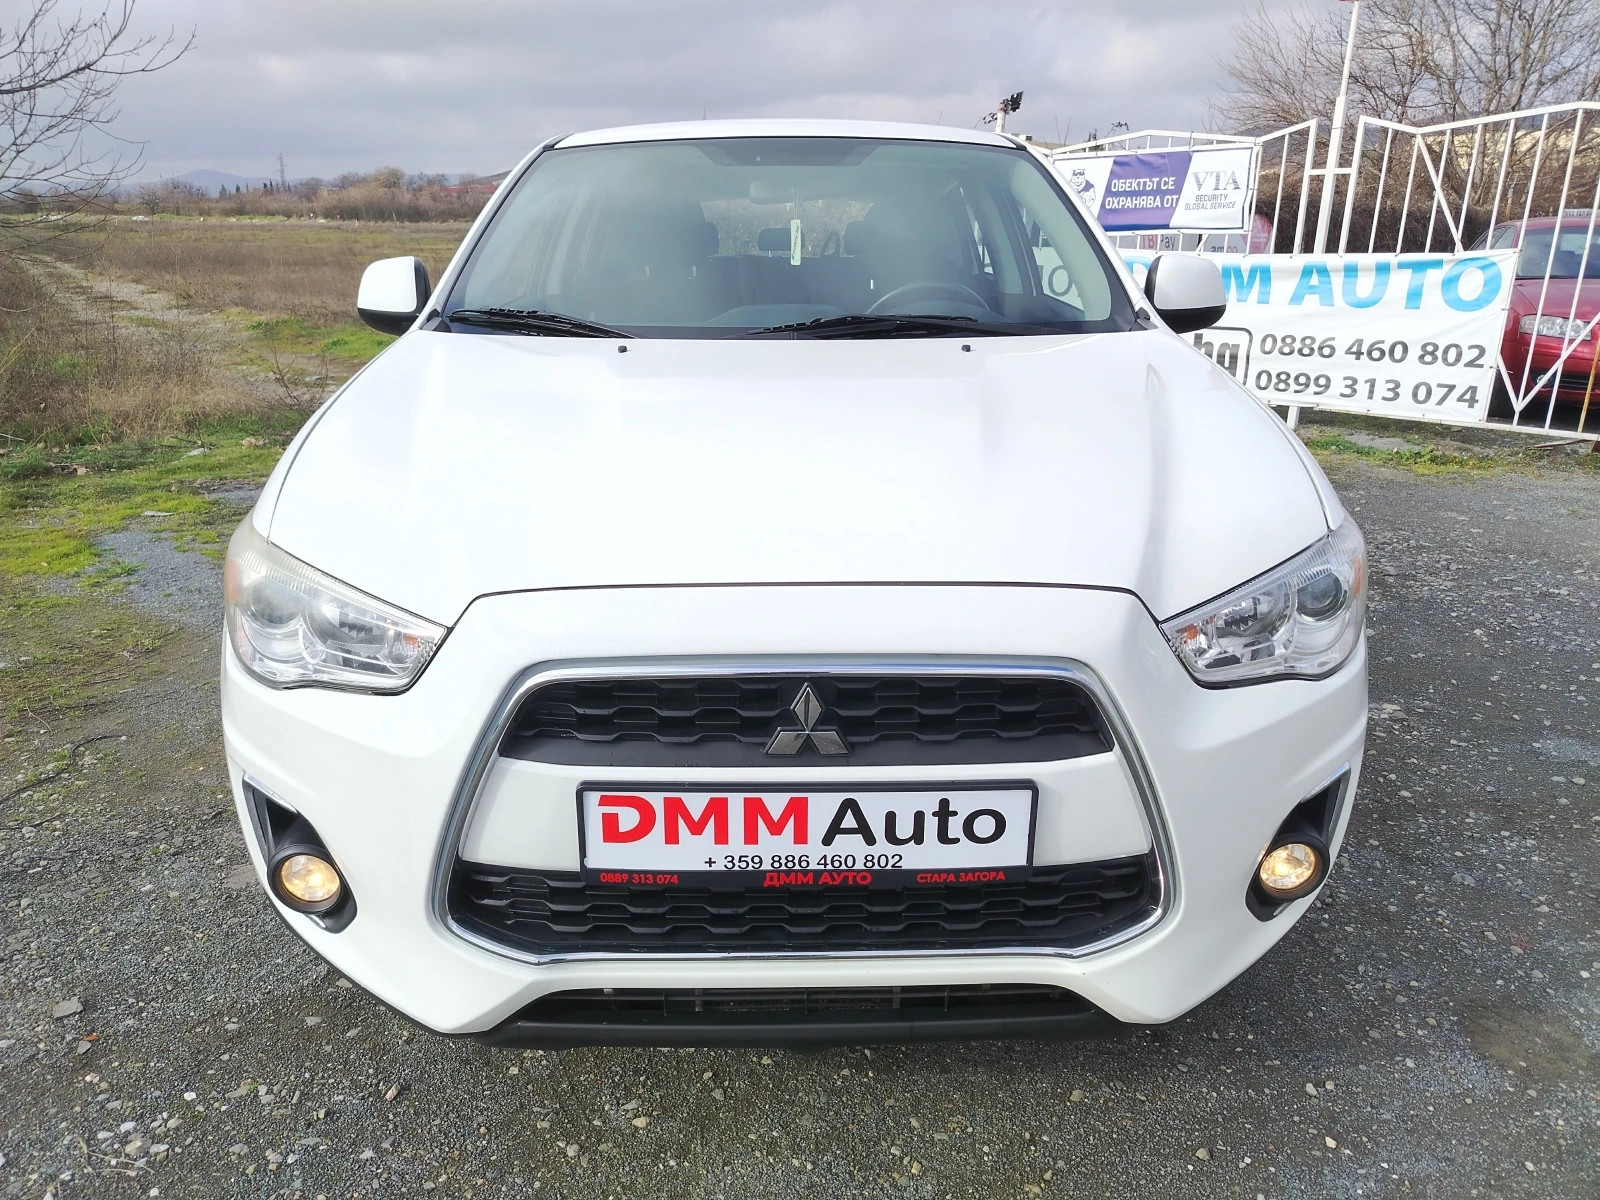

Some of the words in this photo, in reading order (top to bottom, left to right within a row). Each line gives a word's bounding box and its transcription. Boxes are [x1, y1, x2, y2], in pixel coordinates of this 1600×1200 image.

[1111, 178, 1159, 192] ОБЕКТЪТ
[1161, 177, 1176, 190] СЕ
[1192, 170, 1241, 191] VTA
[1105, 196, 1161, 209] ОХРАНЯВА
[1164, 195, 1179, 208] ОТ
[1195, 194, 1228, 203] SECURITY
[1184, 203, 1208, 211] GLOBAL
[1209, 202, 1236, 210] SERVICE
[1288, 257, 1502, 312] AUTO
[1259, 333, 1336, 359] 0886
[1344, 338, 1409, 363] 460
[1418, 342, 1486, 368] 802
[1255, 370, 1331, 395] 0899
[1339, 376, 1401, 402] 313
[1411, 382, 1479, 409] 074
[597, 795, 809, 845] DMM
[820, 797, 1007, 847] Auto
[724, 854, 763, 870] 359
[770, 854, 810, 869] 886
[816, 854, 856, 869] 460
[863, 853, 903, 869] 802
[632, 873, 654, 884] 313
[656, 874, 678, 884] 074
[763, 872, 814, 887] ДММ
[818, 872, 872, 885] АУТО
[916, 872, 956, 883] СТАРА
[959, 871, 1006, 883] ЗАГОРА
